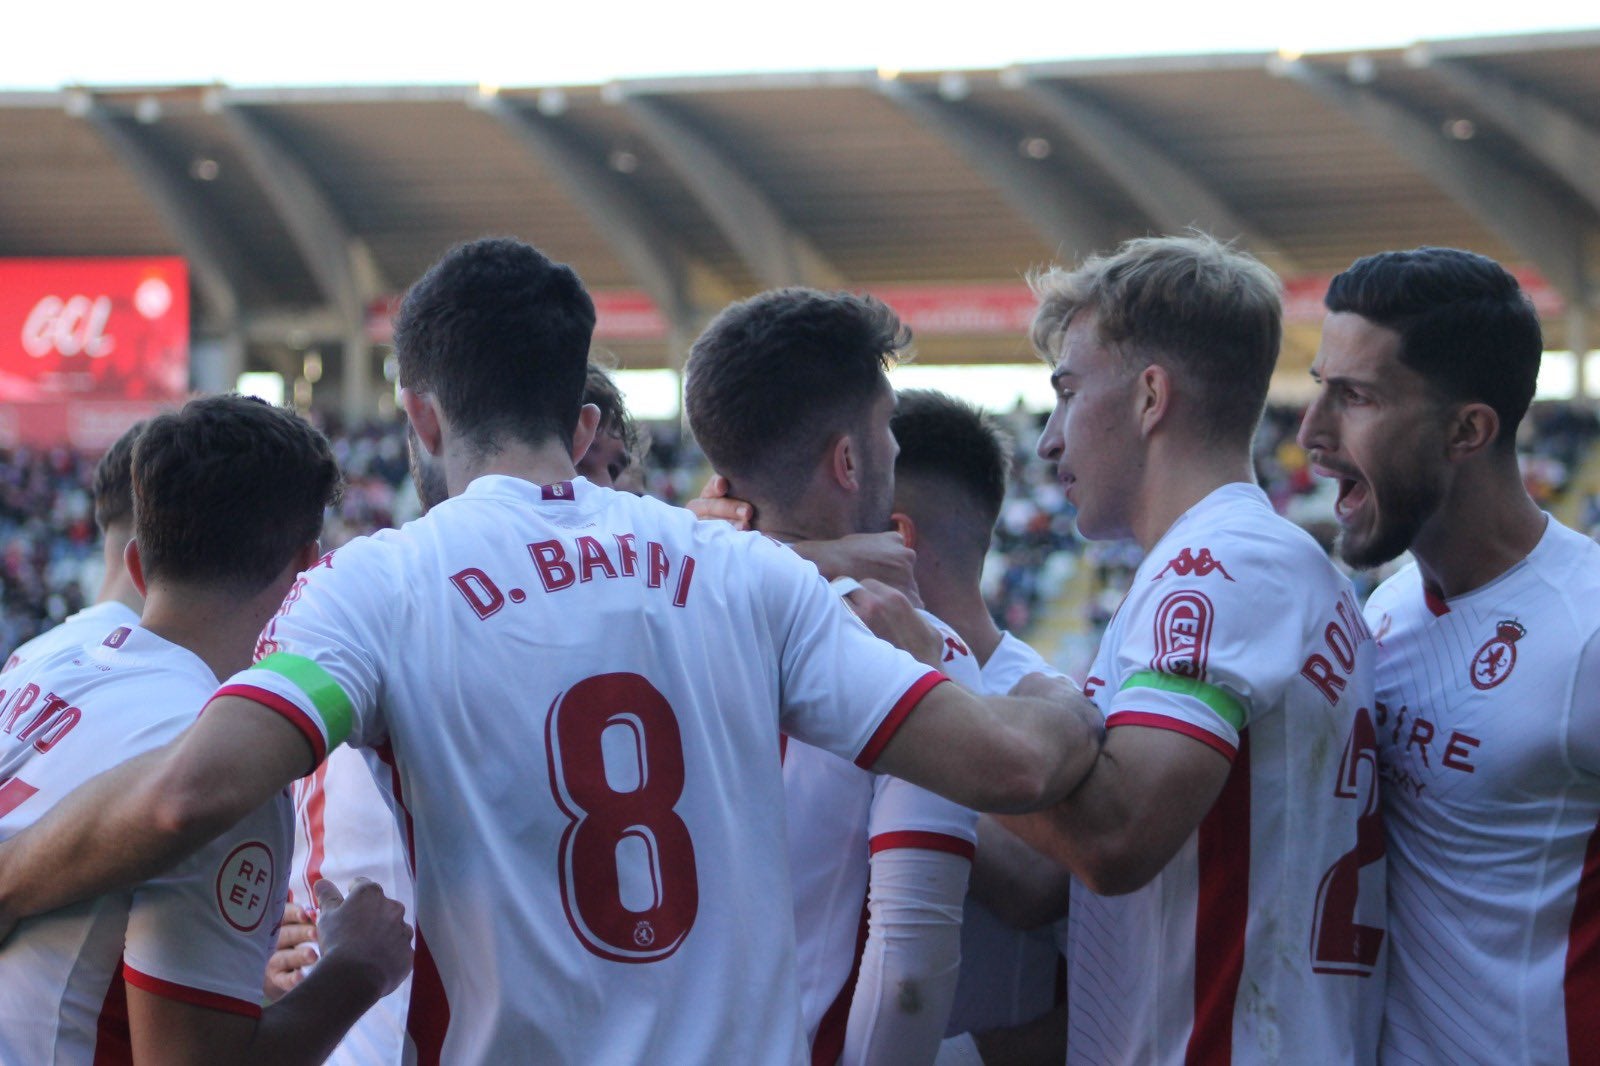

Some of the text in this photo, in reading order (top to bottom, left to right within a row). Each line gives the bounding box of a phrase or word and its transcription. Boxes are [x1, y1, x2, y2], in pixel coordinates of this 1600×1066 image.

[449, 567, 527, 621] D.
[544, 672, 699, 964] 8
[1309, 708, 1386, 978] 2
[229, 883, 260, 911] EF
[238, 859, 267, 886] RF
